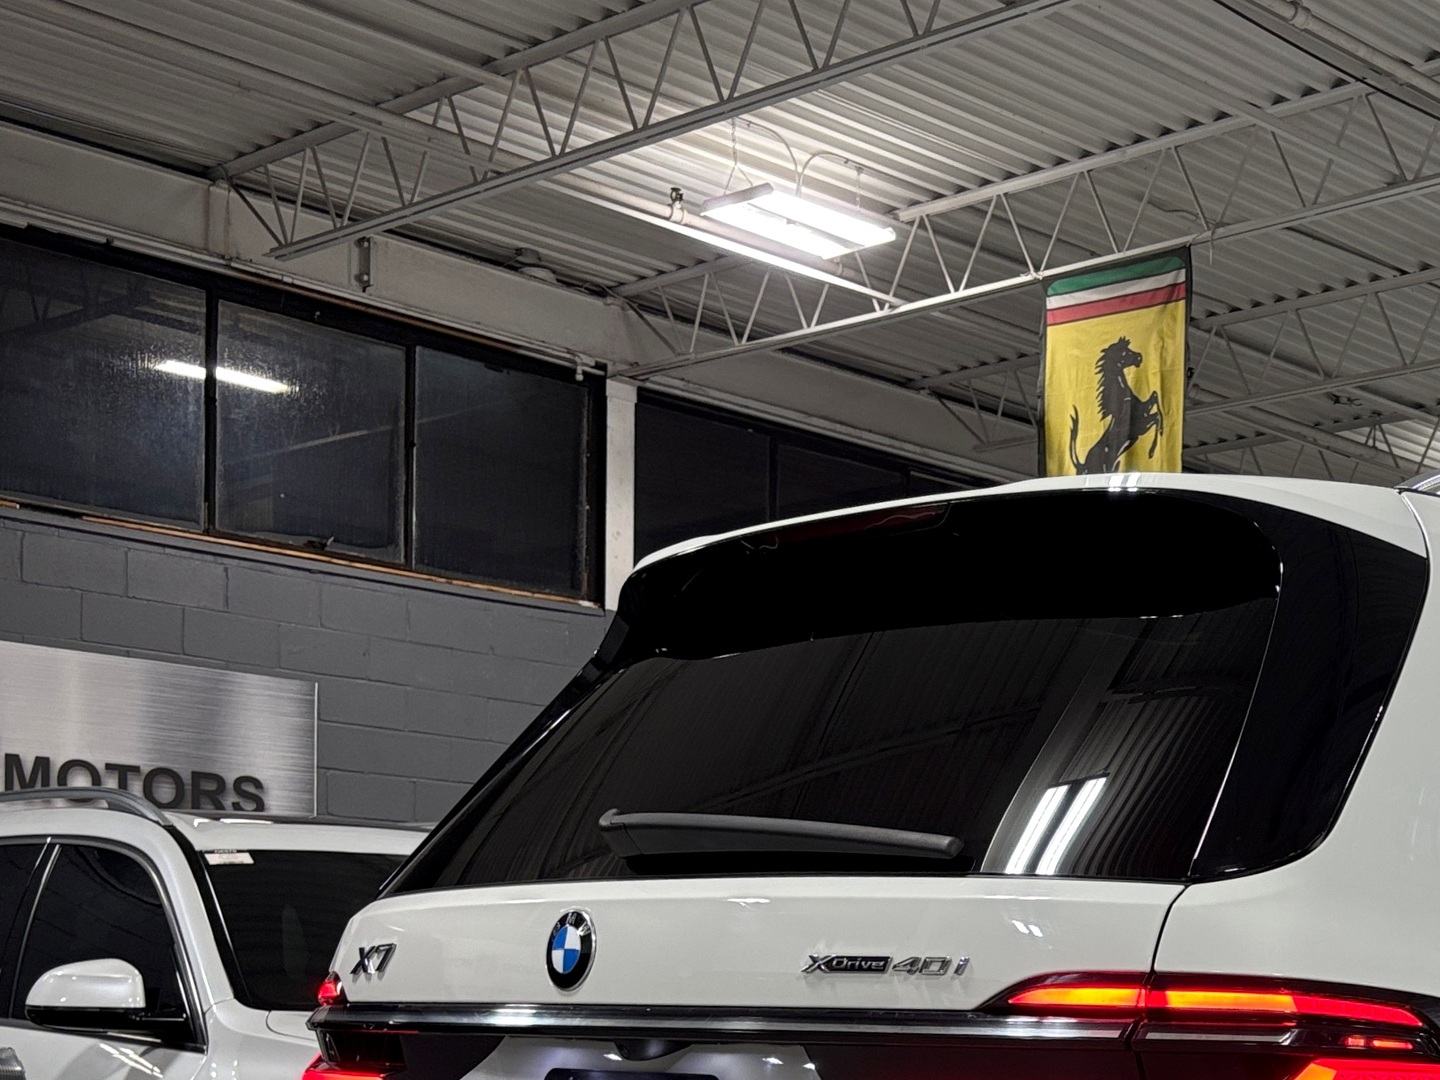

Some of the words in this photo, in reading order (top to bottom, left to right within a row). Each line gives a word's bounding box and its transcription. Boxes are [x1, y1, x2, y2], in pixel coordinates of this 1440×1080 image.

[4, 753, 266, 812] MOTORS
[350, 943, 397, 975] X7
[892, 955, 971, 976] 40i
